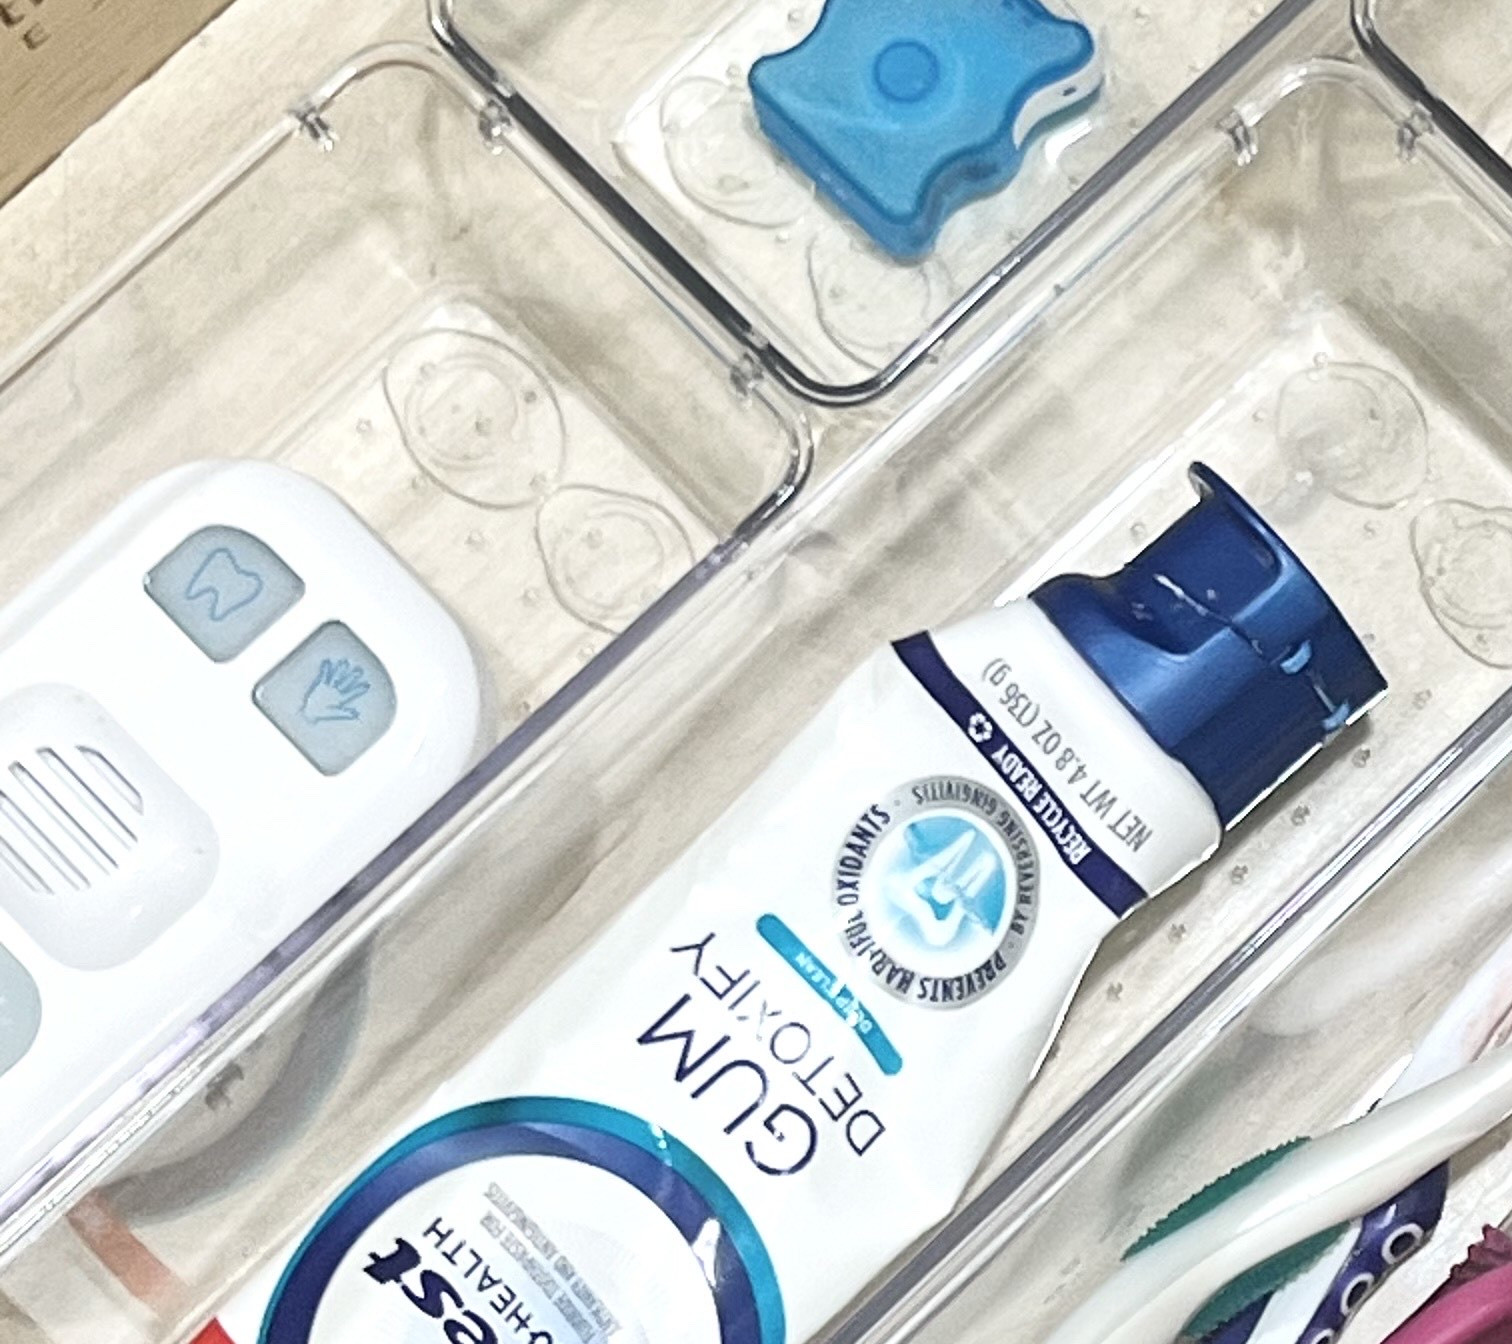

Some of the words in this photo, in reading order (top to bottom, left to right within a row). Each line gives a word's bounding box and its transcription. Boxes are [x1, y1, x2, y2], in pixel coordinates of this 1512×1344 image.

[1028, 718, 1065, 755] OZ
[989, 741, 1044, 801] READY
[1051, 746, 1092, 788] 4.8
[1031, 790, 1092, 866] RECYCLE
[1078, 777, 1119, 819] WT
[836, 800, 891, 912] OXIDANTS
[992, 808, 1035, 904] REVERSING
[1106, 806, 1155, 852] NET
[914, 951, 1009, 1001] PREVENTS
[669, 931, 886, 1157] DETOXIFY
[635, 993, 818, 1176] GUM
